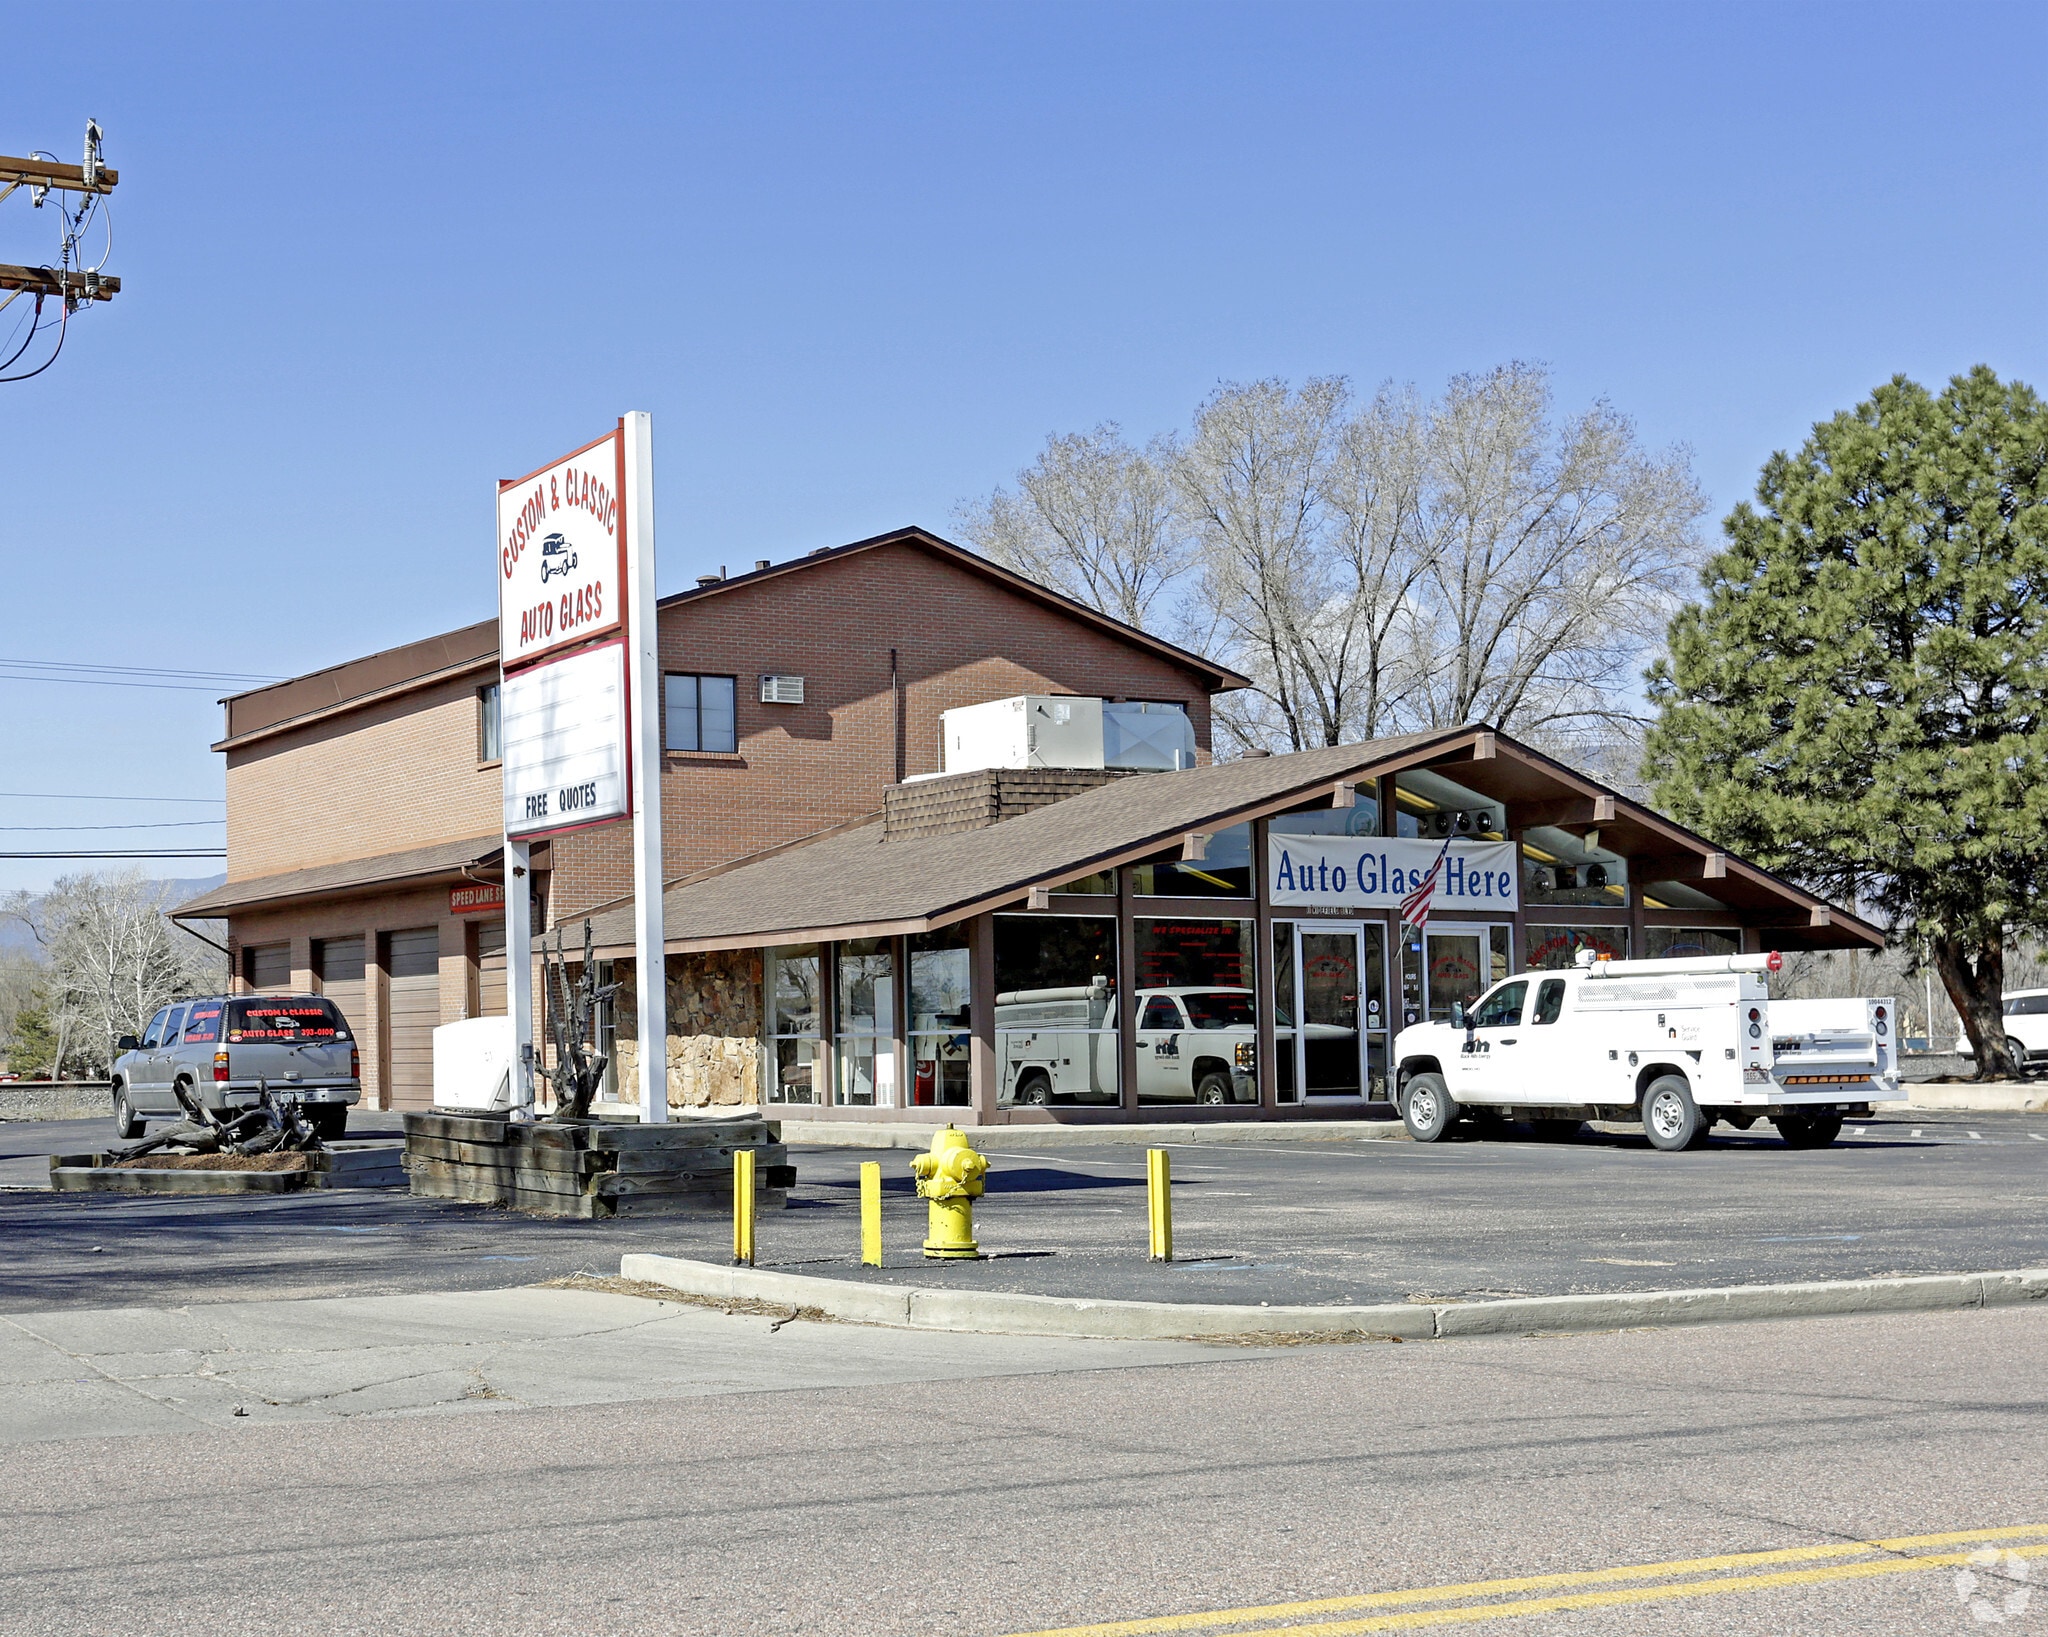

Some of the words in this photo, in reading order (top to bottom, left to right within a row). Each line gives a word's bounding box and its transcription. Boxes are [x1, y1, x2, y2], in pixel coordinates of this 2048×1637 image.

[503, 484, 546, 579] CUSTOM
[551, 474, 560, 511] &
[566, 468, 616, 536] CLASSIC
[520, 601, 553, 647] AUTO
[560, 581, 602, 631] GLASS
[526, 793, 548, 818] FREE
[559, 782, 597, 811] QUOTES
[1276, 850, 1347, 893] Auto
[1445, 857, 1511, 897] Here
[452, 891, 475, 906] SPEED
[476, 887, 494, 903] LANE
[1169, 926, 1219, 935] SPECIALIZE
[246, 1008, 281, 1018] CUSTOM
[282, 1008, 289, 1016] &
[289, 1008, 323, 1017] CLASSIC
[242, 1029, 266, 1038] AUTO
[267, 1028, 295, 1038] GLASS
[301, 1027, 335, 1037] 393-0100
